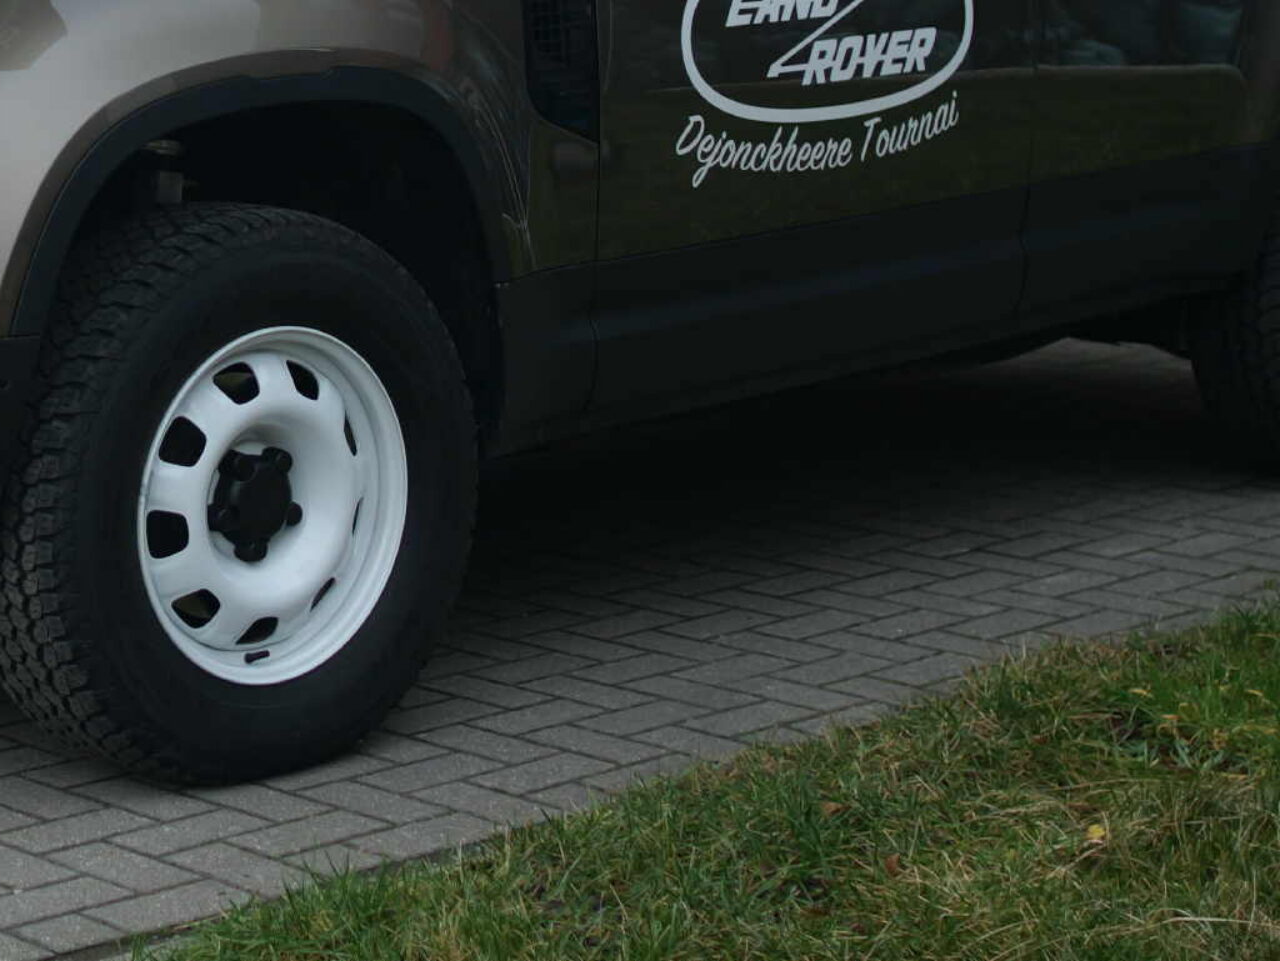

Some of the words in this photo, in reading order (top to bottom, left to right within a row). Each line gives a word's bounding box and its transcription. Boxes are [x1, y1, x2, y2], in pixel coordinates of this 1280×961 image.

[801, 27, 938, 86] ROVER
[676, 114, 853, 189] Dejonckheere
[859, 90, 960, 162] Tournai
